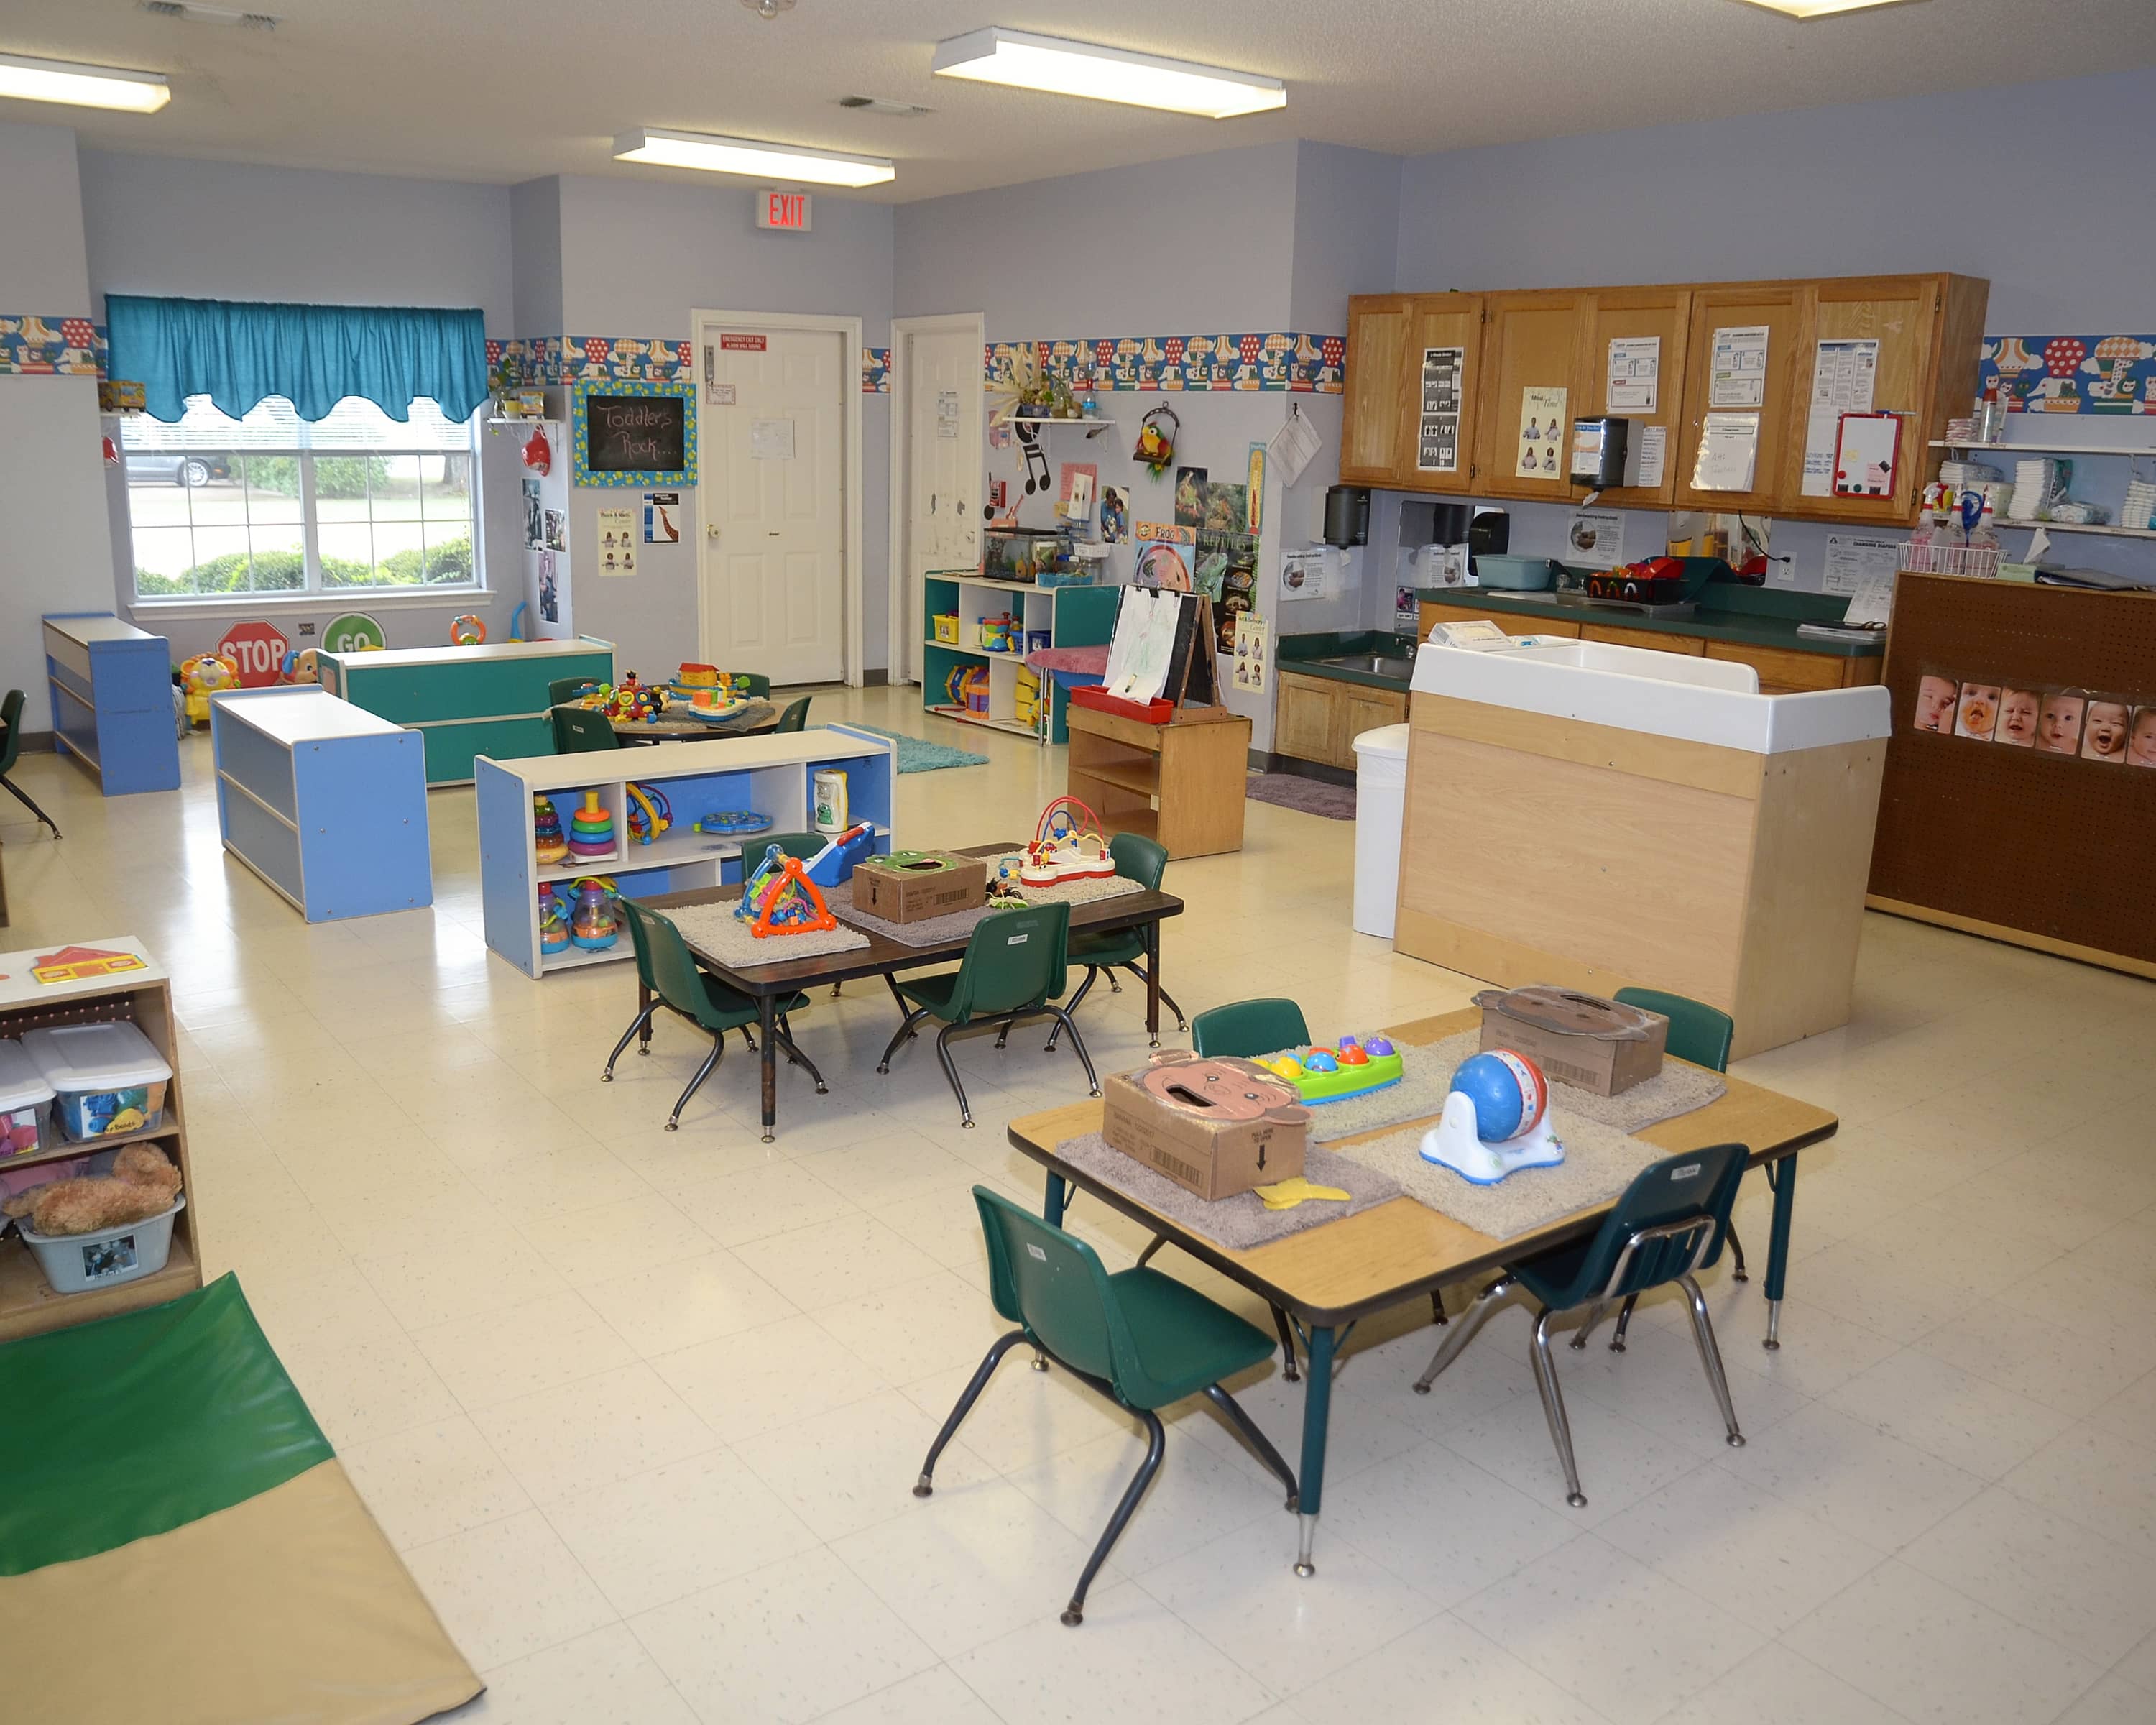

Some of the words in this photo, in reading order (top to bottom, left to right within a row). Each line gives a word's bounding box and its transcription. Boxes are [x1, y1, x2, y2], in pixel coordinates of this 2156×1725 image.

[770, 193, 804, 228] EXIT
[1156, 526, 1175, 540] FROG
[1203, 534, 1246, 551] REPTILES
[337, 632, 372, 653] GO
[221, 639, 286, 673] STOP
